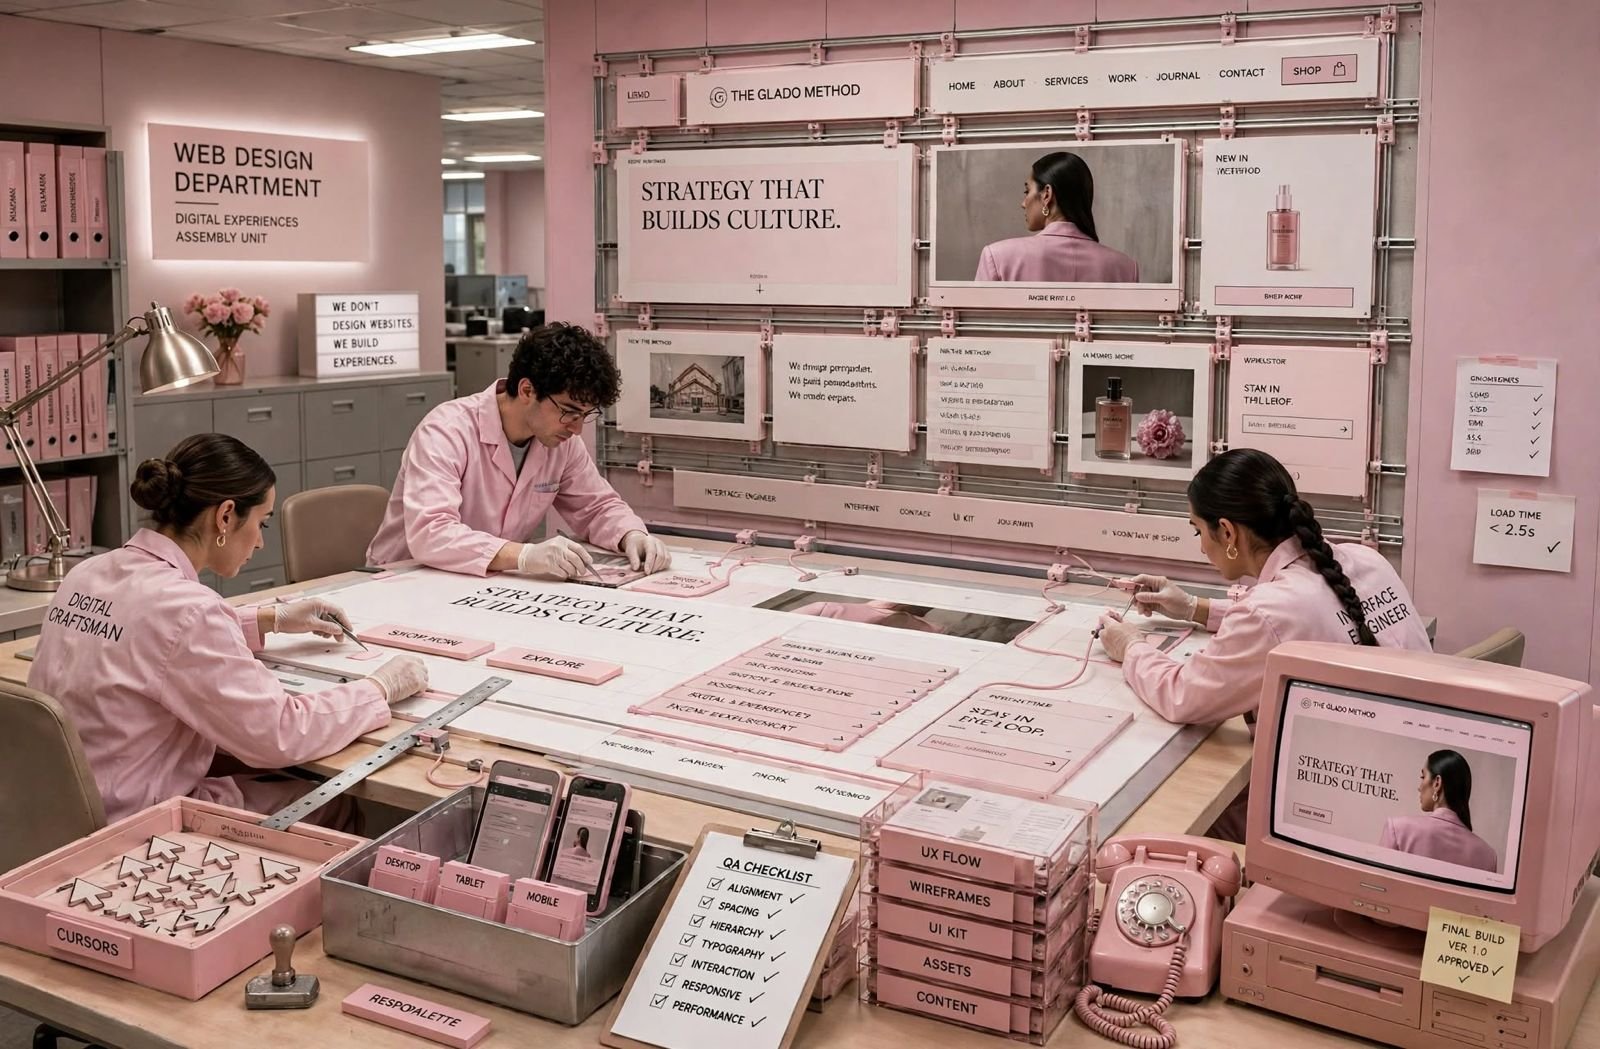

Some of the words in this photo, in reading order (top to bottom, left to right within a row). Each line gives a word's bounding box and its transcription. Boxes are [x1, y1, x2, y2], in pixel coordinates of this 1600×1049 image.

[948, 82, 976, 91] HOME
[993, 80, 1025, 88] ABOUT
[1044, 76, 1088, 86] SERVICES
[1108, 74, 1137, 84] WORK
[1156, 71, 1200, 82] JOURNAL
[1219, 68, 1266, 78] CONTACT
[1293, 66, 1322, 76] SHOP
[730, 88, 754, 102] THE
[757, 86, 801, 100] GLADO
[804, 84, 860, 98] METHOD
[174, 142, 226, 164] WEB
[236, 147, 313, 170] DESIGN
[175, 172, 321, 197] DEPARTMENT
[642, 180, 754, 201] STRATEGY
[760, 178, 824, 200] THAT
[176, 213, 220, 225] DIGITAL
[224, 215, 298, 228] EXPERIENCES
[642, 210, 720, 230] BUILDS
[727, 209, 841, 230] CULTURE.
[176, 232, 236, 244] ASSEMBLY
[242, 233, 268, 244] UNIT
[332, 302, 346, 312] WE
[350, 302, 379, 312] DON'T
[332, 320, 366, 330] DESIGN
[370, 318, 415, 329] WEBSITES.
[334, 339, 348, 349] WE
[351, 338, 379, 348] BUILD
[333, 356, 397, 368] EXPERIENCES.
[1269, 384, 1280, 393] IN
[964, 514, 976, 523] KIT
[1490, 509, 1516, 518] LOAD
[1518, 510, 1542, 520] TIME
[1504, 524, 1535, 538] 2.5s
[68, 592, 113, 618] DIGITAL
[476, 586, 618, 612] STRATEGY
[620, 605, 703, 624] THAT
[1336, 586, 1398, 626] INRFACE
[48, 607, 124, 642] CRAFTSMAN
[448, 596, 559, 619] BUILDS
[558, 611, 705, 642] CULTURE.
[1348, 604, 1410, 645] EGINEER
[522, 654, 585, 670] EXPLORE
[1014, 714, 1035, 722] IN
[1313, 701, 1325, 709] THE
[1348, 708, 1376, 718] METHOD
[1298, 754, 1358, 777] STRATEGY
[1360, 768, 1394, 784] THAT
[1296, 768, 1339, 788] BUILDS
[1341, 780, 1400, 802] CULTURE.
[385, 856, 422, 872] DESKTOP
[921, 846, 939, 860] UX
[942, 850, 982, 868] FLOW
[723, 857, 740, 870] QA
[744, 862, 813, 884] CHECKLIST
[455, 874, 485, 890] TABLET
[727, 883, 784, 902] ALIGNMENT
[526, 891, 560, 908] MOBILE
[909, 879, 992, 908] WIREFRAMES
[718, 902, 760, 918] SPACING
[710, 920, 764, 939] HIERARCHY
[929, 922, 942, 935] UI
[948, 926, 968, 940] KIT
[1442, 923, 1470, 938] FINAL
[1475, 930, 1505, 945] BUILD
[56, 927, 120, 957] CURSORS
[702, 938, 766, 961] TYPOGRAPHY
[1449, 940, 1468, 953] VER
[1472, 946, 1488, 956] 1.0
[691, 959, 756, 981] INTERACTION
[923, 956, 972, 978] ASSETS
[1437, 954, 1489, 974] APPROVED
[681, 980, 742, 1002] RESPONSIVE
[672, 1000, 746, 1025] PERFORMANCE
[916, 990, 978, 1015] CONTENT
